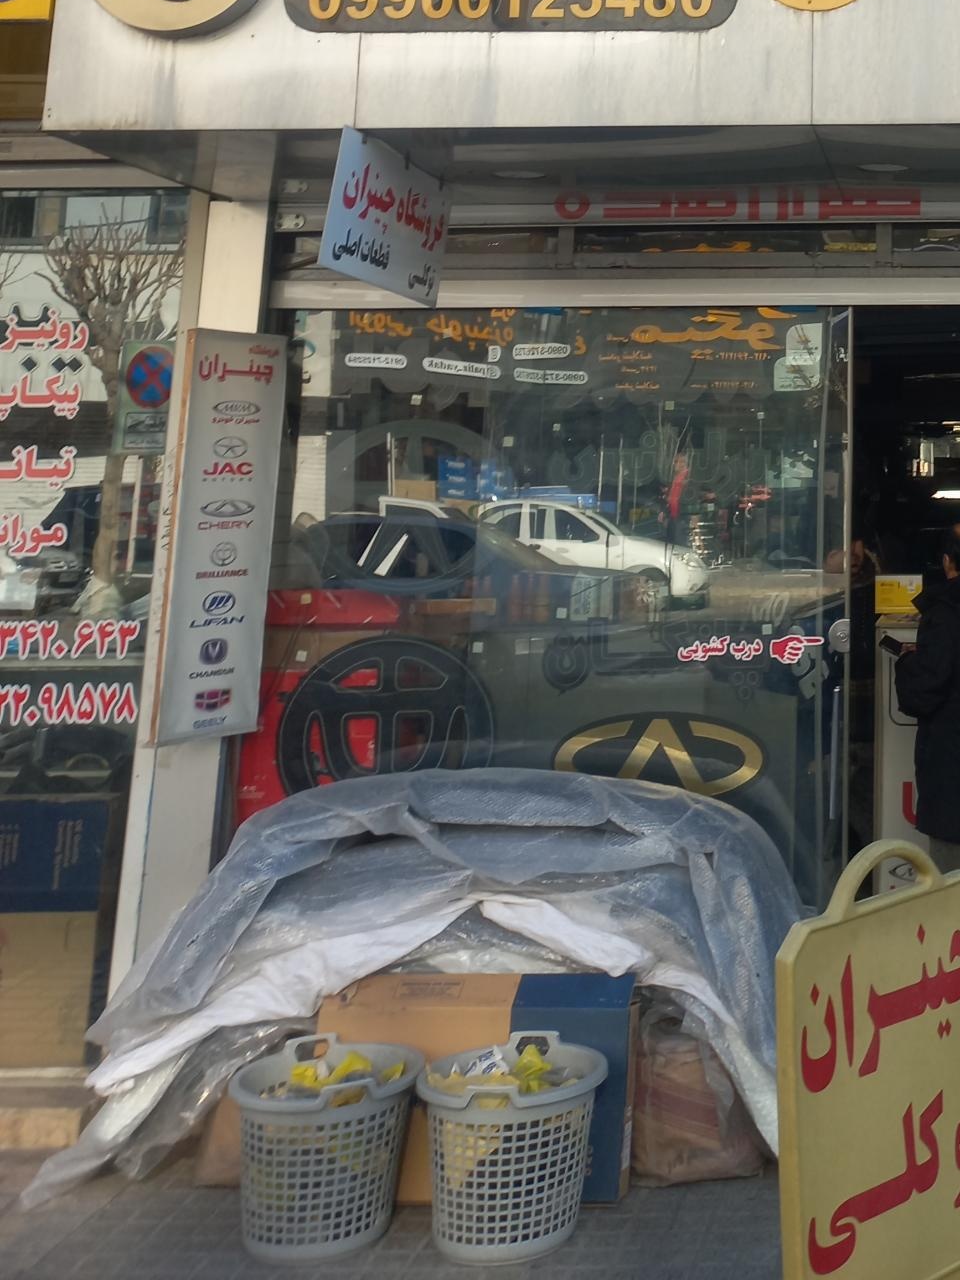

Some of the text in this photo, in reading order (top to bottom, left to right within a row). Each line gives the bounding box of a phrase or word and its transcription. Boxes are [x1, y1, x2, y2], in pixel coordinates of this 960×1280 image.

[342, 163, 446, 252] فروشگاه چینران
[332, 228, 391, 270] قطعات اصلی
[0, 308, 90, 352] رونیز
[199, 353, 274, 386] چینران
[203, 462, 253, 475] JAC
[198, 520, 254, 530] CHERY
[196, 569, 248, 579] BRILLIANCE
[189, 616, 245, 629] LIFAN
[677, 635, 764, 662] درب کشویی
[193, 716, 227, 729] GEELY
